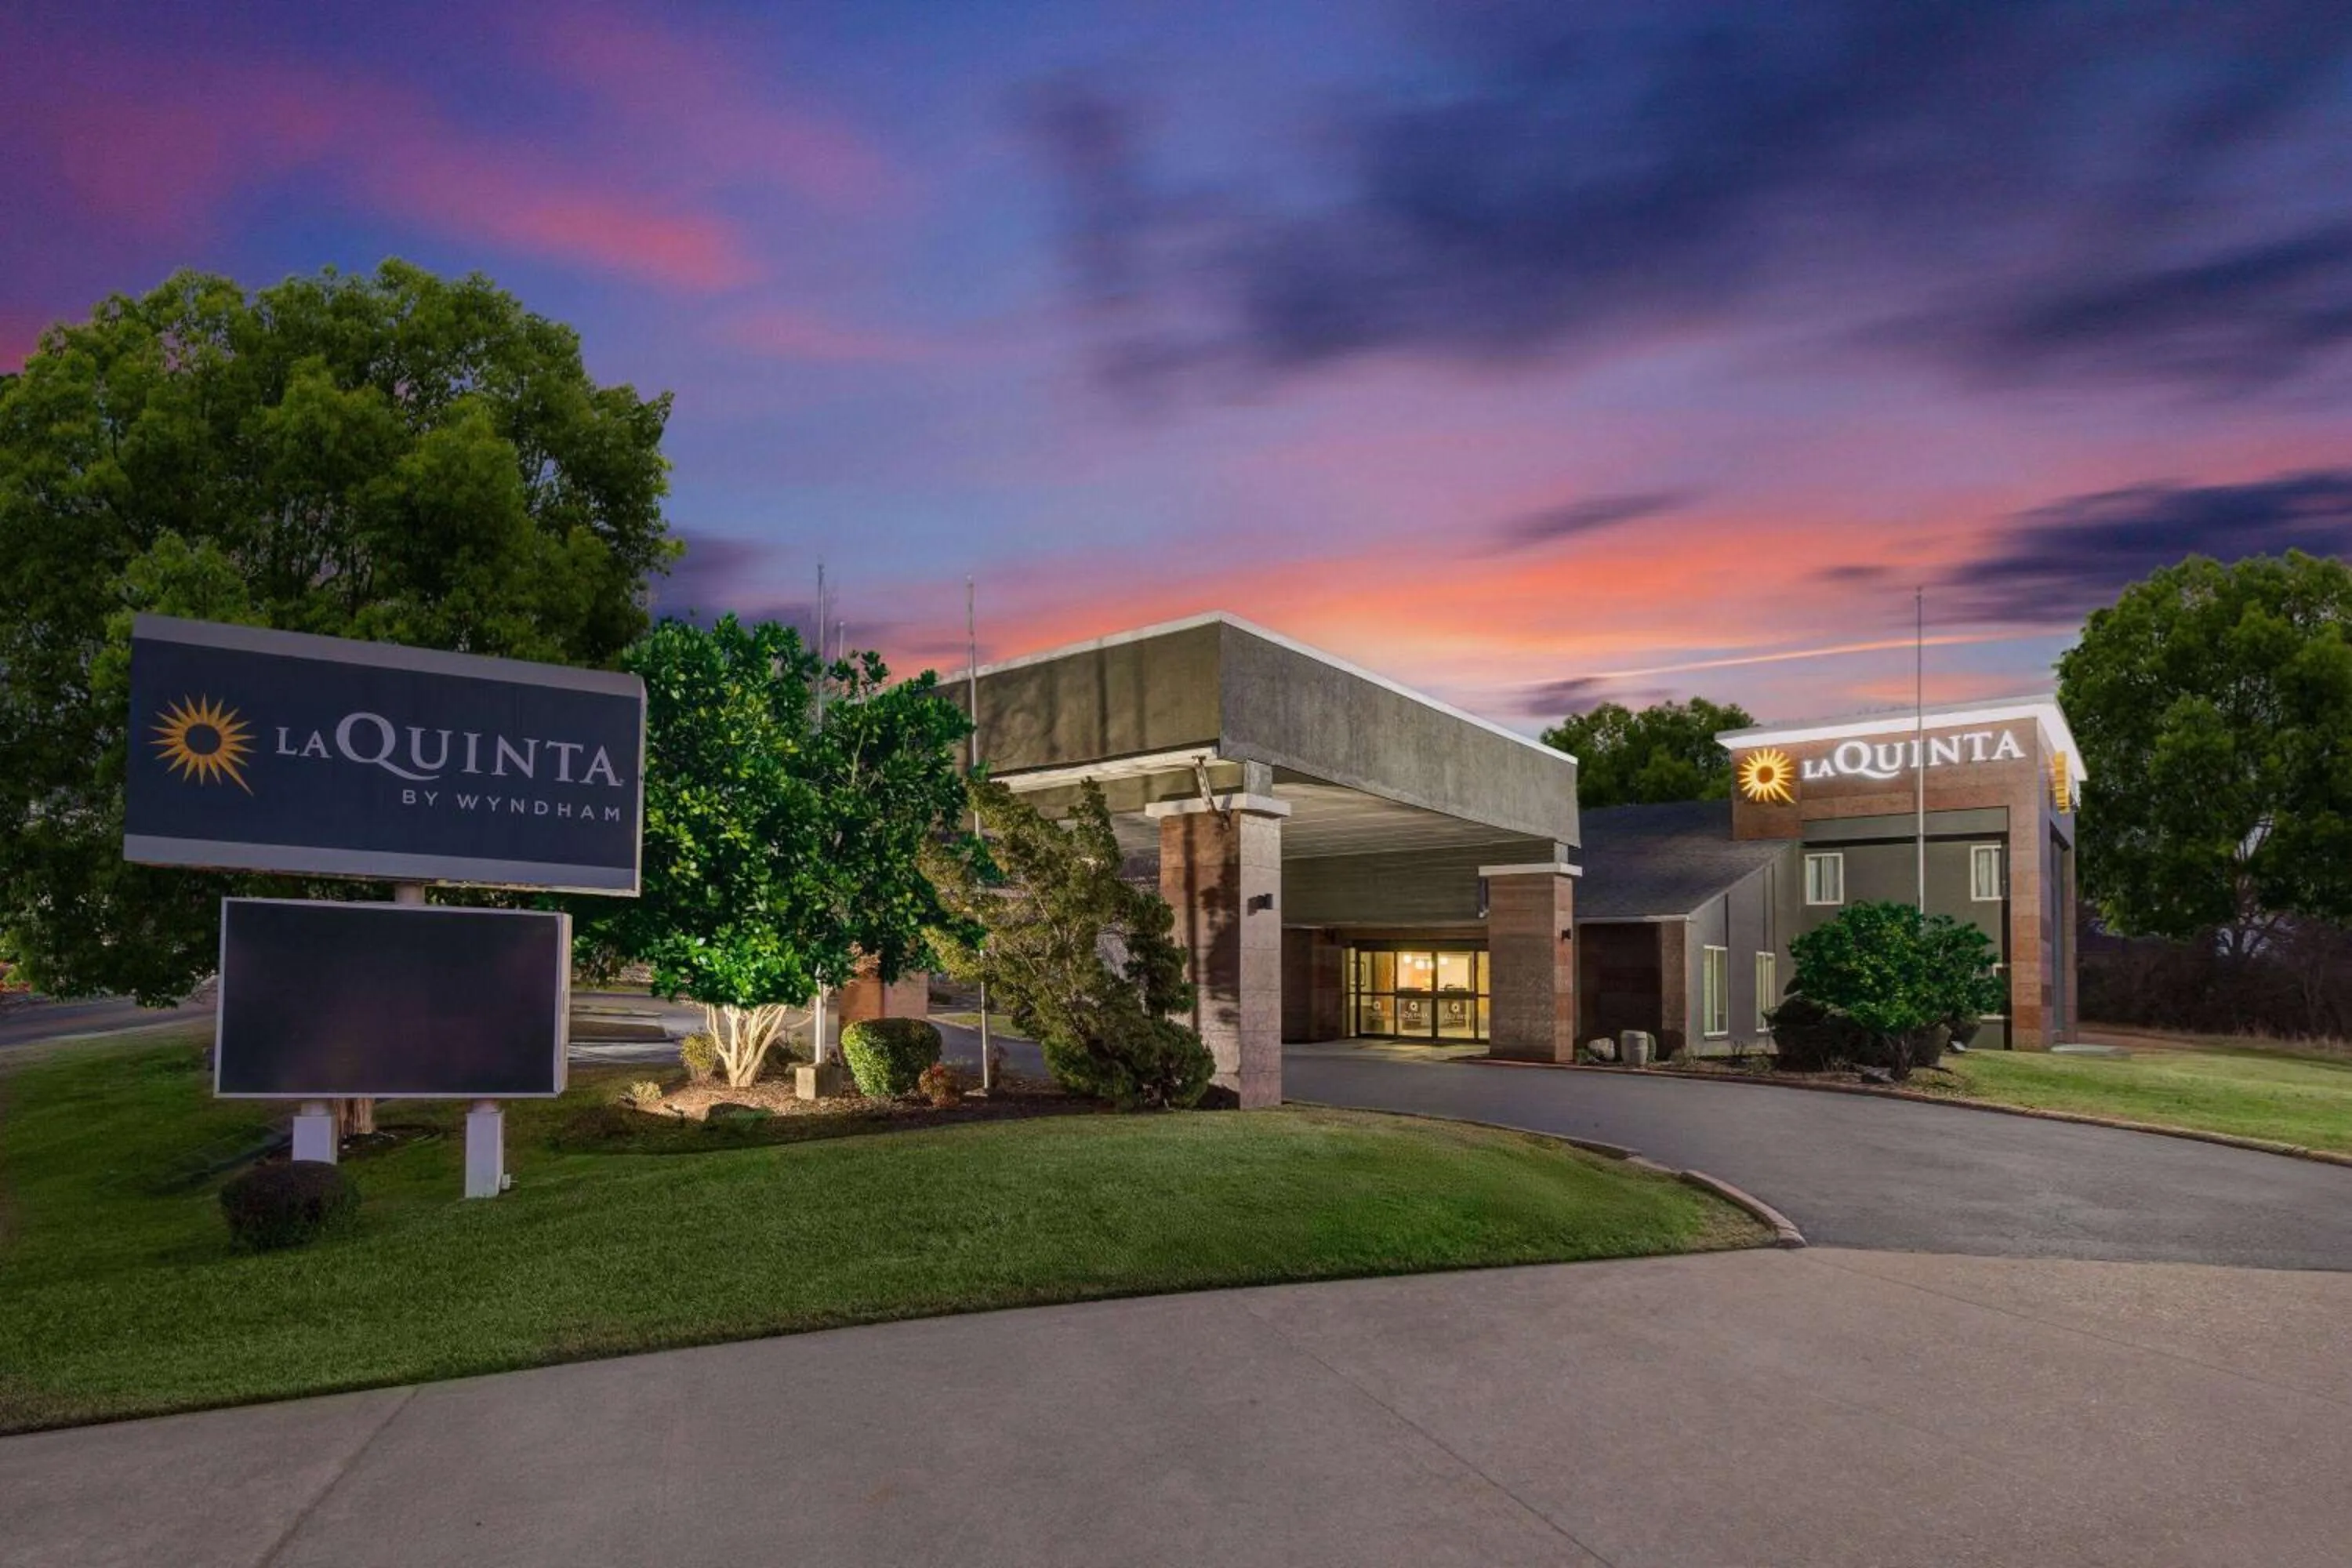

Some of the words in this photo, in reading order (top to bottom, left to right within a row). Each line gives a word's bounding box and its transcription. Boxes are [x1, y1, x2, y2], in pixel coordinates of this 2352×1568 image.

[276, 727, 332, 759] LA
[336, 712, 624, 786] QUINTA
[1804, 759, 1835, 779] LA
[1835, 729, 2026, 779] QUINTA
[402, 789, 439, 807] BY
[456, 793, 621, 822] WYNDHAM
